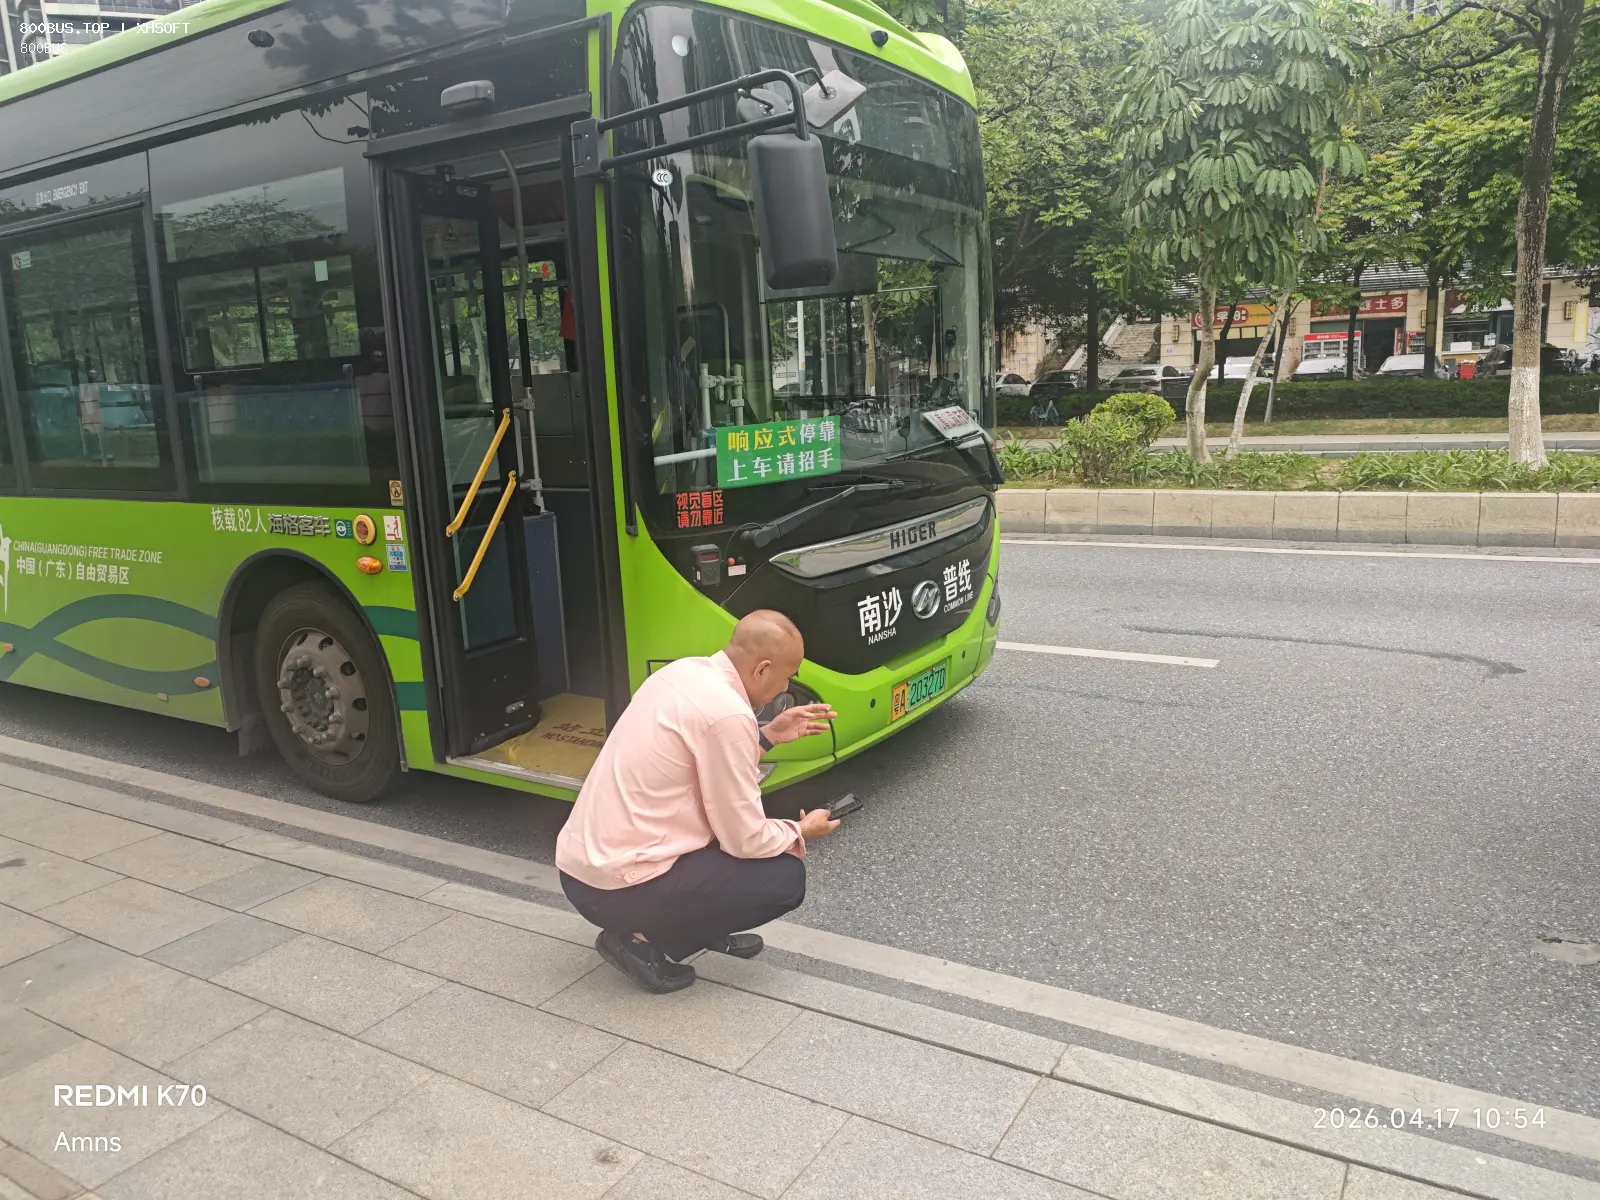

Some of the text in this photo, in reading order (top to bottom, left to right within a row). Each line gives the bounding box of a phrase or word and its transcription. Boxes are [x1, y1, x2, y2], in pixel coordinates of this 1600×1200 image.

[727, 420, 835, 453] 响应式停靠
[727, 447, 834, 482] 上车请招手
[676, 490, 724, 511] 视觉盲区
[211, 506, 267, 533] 核载82人
[267, 513, 331, 537] 海格客车
[677, 508, 724, 529] 请勿靠近
[889, 520, 937, 550] HIGER
[88, 546, 108, 559] FREE
[110, 547, 137, 562] TRADE
[138, 549, 163, 564] ZONE
[942, 558, 972, 602] 普线
[857, 586, 903, 637] 南沙
[943, 590, 974, 613] COMMON LINE
[868, 627, 897, 646] NANSHA
